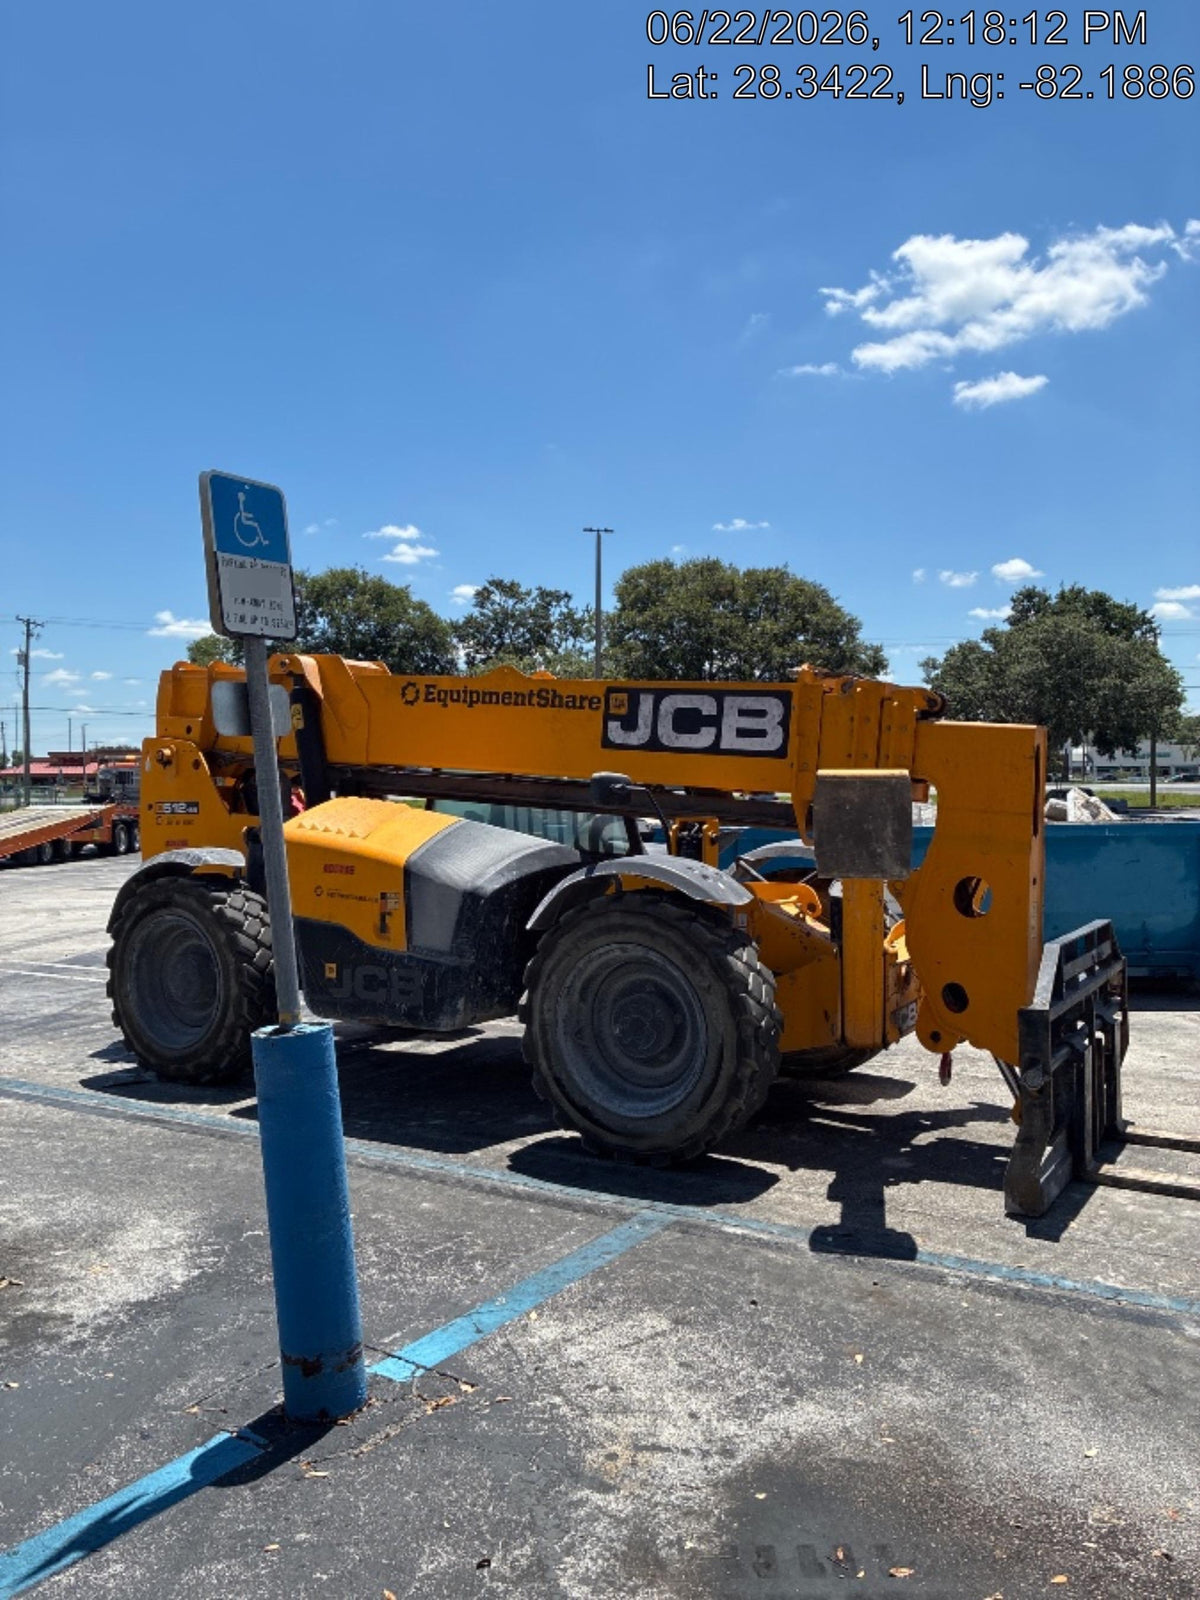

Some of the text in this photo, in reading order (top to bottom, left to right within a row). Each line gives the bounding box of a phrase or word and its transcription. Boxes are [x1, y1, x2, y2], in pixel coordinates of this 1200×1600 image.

[424, 684, 601, 710] EquipmentShare
[607, 693, 784, 751] JCB
[327, 965, 423, 1004] JCB
